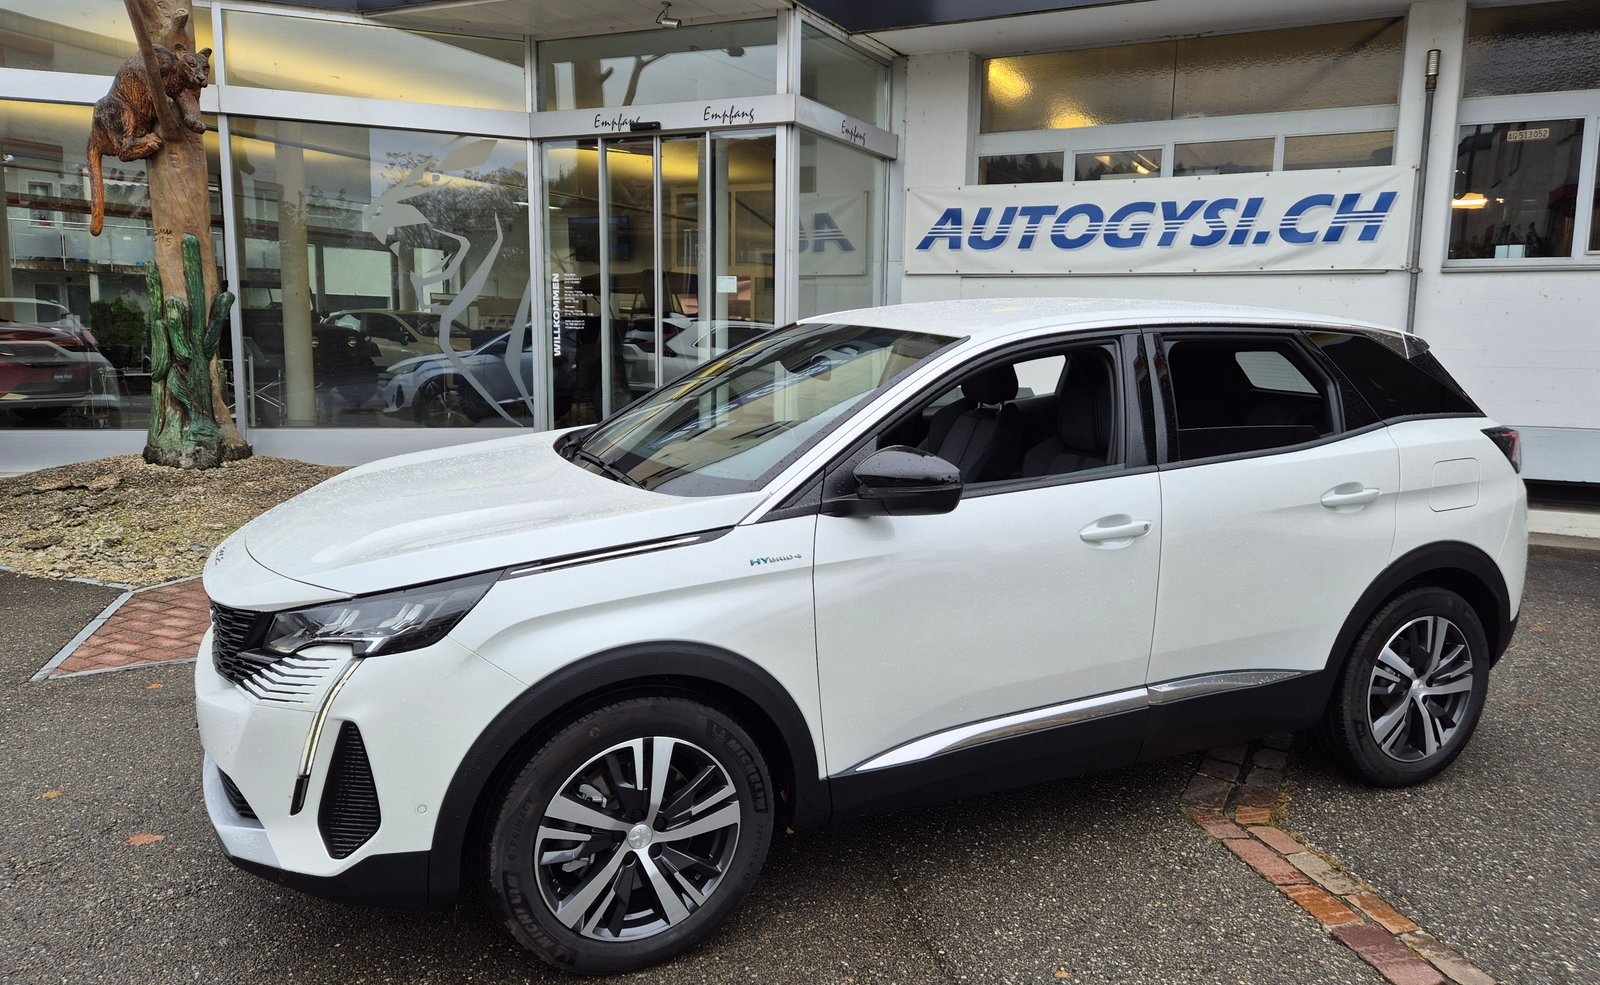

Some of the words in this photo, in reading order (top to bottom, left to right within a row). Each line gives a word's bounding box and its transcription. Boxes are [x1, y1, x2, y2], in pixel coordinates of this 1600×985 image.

[704, 105, 755, 124] Empfang
[841, 119, 866, 146] Empfang
[915, 190, 1398, 252] AUTOGYSI.CH
[552, 273, 561, 357] WILLKOMMEN
[725, 738, 766, 812] MICHELIN
